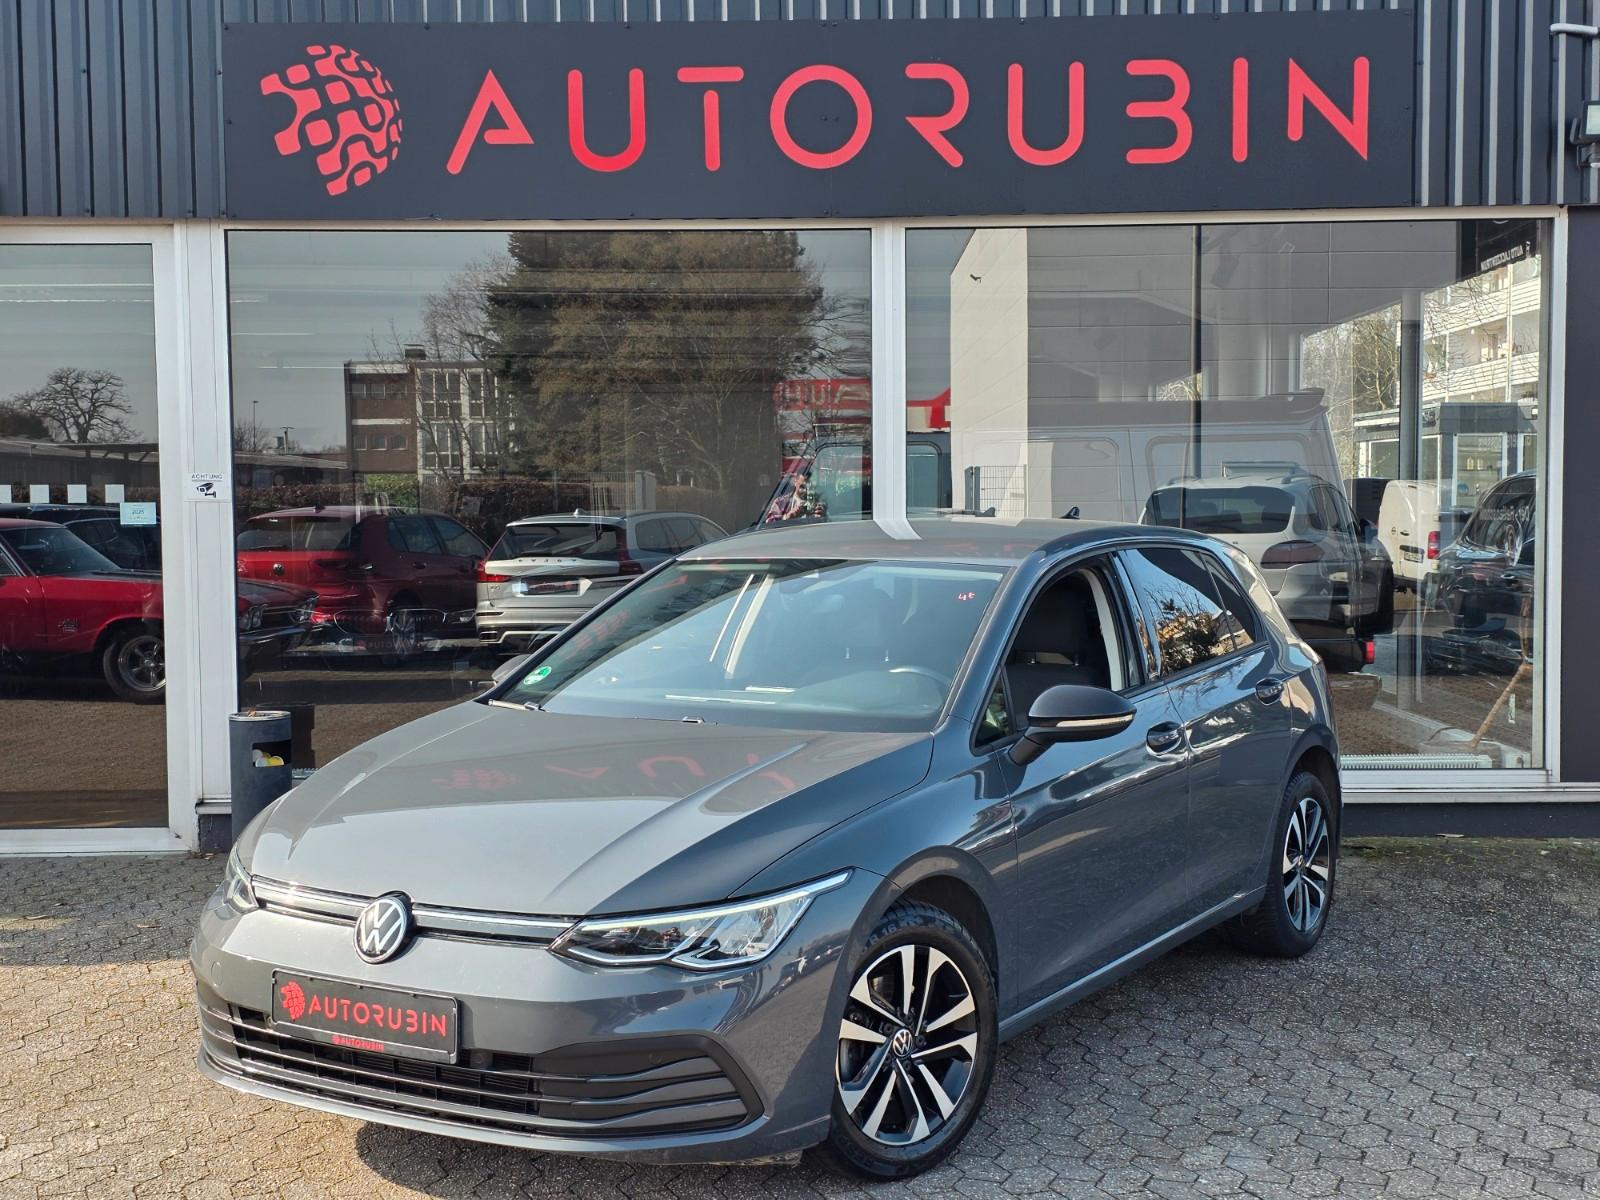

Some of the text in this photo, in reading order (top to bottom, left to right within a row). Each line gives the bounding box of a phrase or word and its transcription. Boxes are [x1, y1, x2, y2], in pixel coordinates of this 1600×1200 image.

[446, 56, 1370, 175] AUTORUBIN
[308, 994, 447, 1037] AUTORUBIN
[340, 1036, 385, 1052] AUTORUBIN
